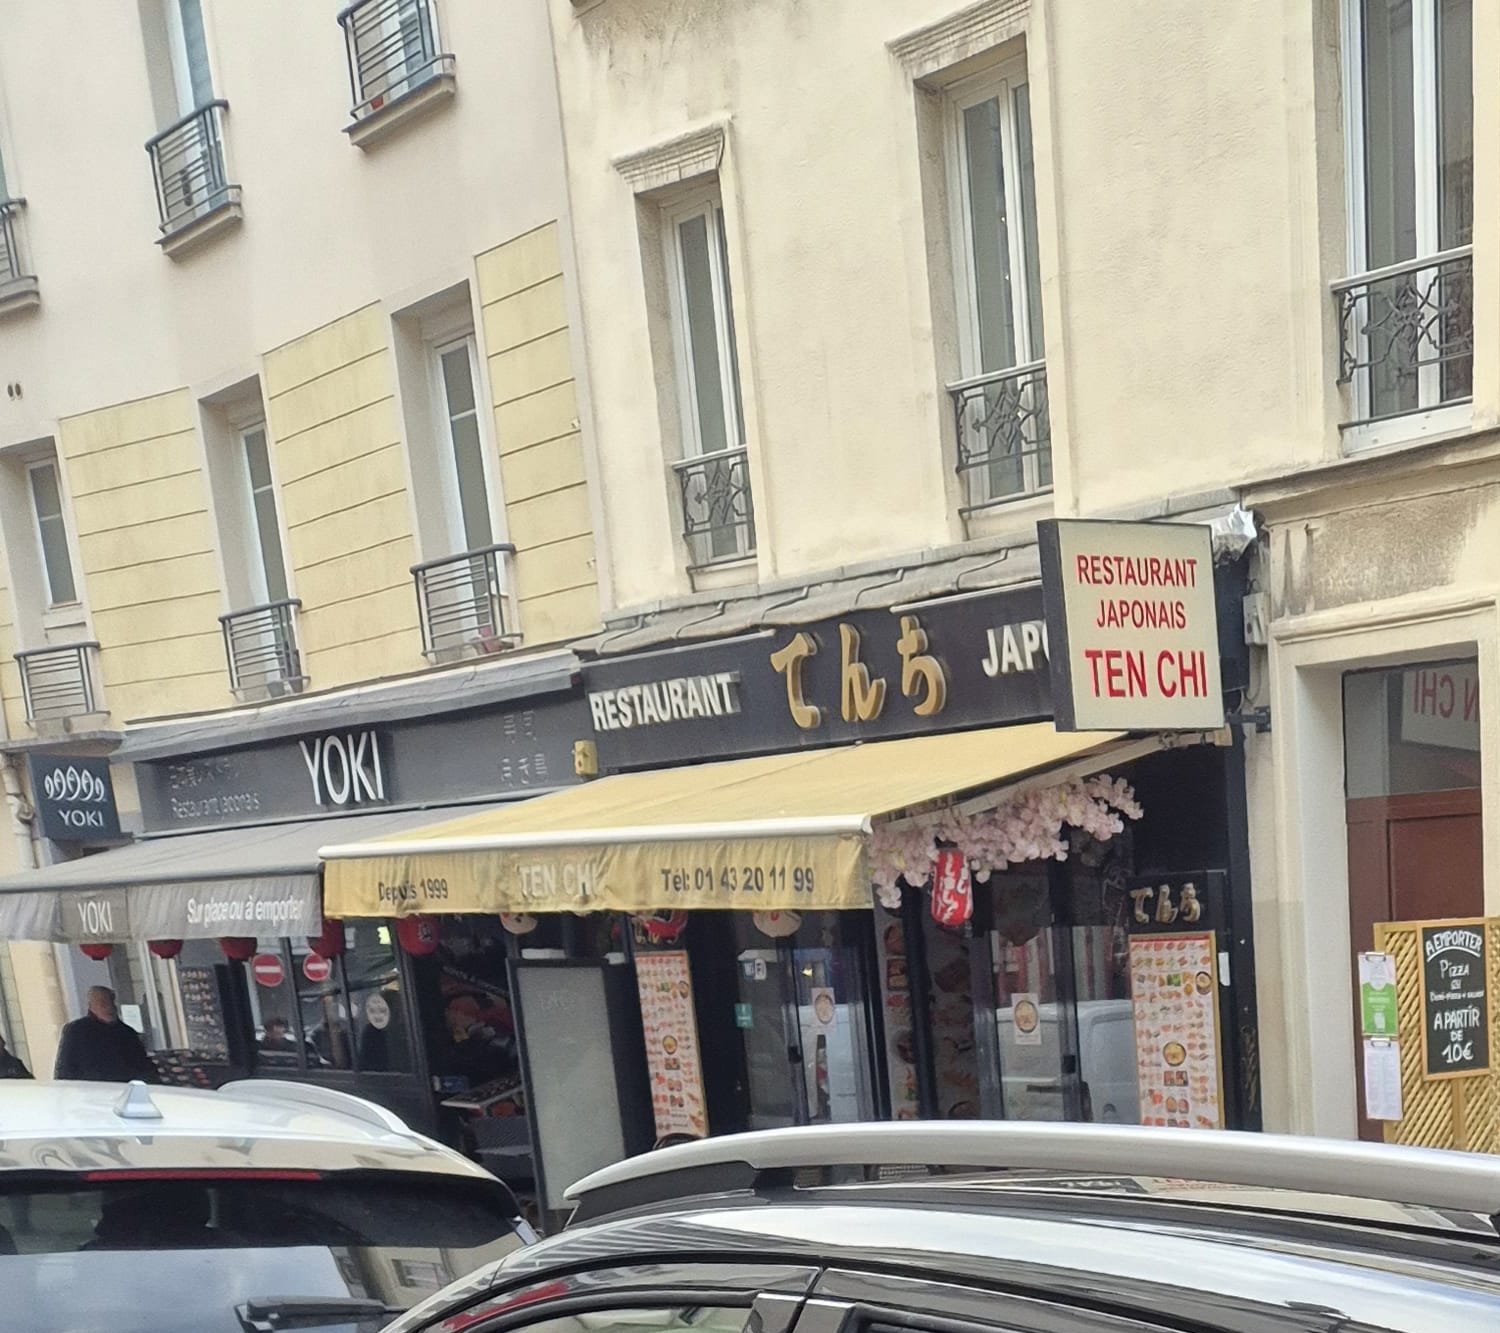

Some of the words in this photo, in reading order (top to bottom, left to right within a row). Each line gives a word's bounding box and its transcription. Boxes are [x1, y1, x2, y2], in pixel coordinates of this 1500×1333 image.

[1076, 554, 1198, 588] RESTAURANT
[1096, 600, 1187, 630] JAPONAIS
[769, 615, 948, 729] てんち
[1084, 649, 1148, 698] TEN
[1156, 649, 1209, 698] CHI
[588, 672, 738, 732] RESTAURANT
[299, 730, 385, 806] YOKI
[58, 809, 104, 827] YOKI
[420, 877, 449, 900] 1999
[518, 863, 556, 898] TEN
[661, 867, 690, 892] Tél:
[694, 867, 714, 892] 01
[720, 867, 738, 892] 43
[743, 866, 764, 892] 20
[769, 866, 786, 892] 11
[793, 866, 815, 893] 99
[78, 901, 113, 934] YOKI
[187, 898, 204, 924] Sur
[204, 895, 229, 928] place
[229, 903, 244, 921] ou
[1434, 930, 1483, 952] EMPORTER
[1450, 1030, 1464, 1041] DE
[1441, 1041, 1474, 1064] 10€
